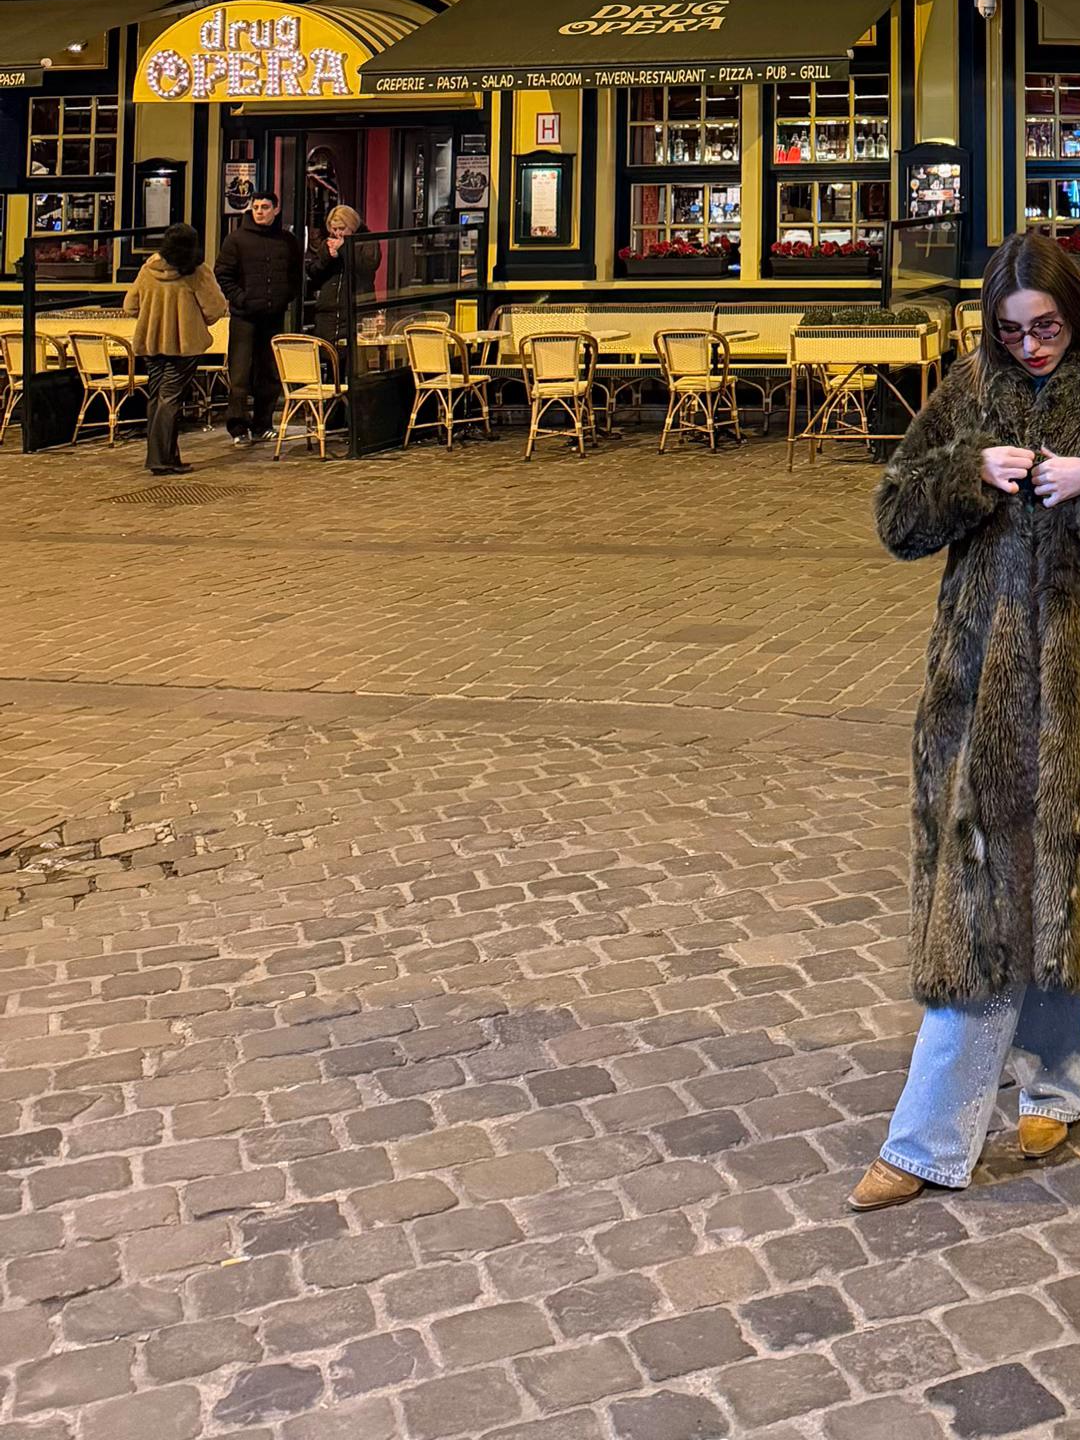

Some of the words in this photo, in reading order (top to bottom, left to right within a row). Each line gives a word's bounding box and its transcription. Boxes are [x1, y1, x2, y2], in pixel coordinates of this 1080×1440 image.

[590, 0, 730, 20] DRUG
[200, 7, 302, 56] drug
[558, 16, 727, 36] OPERA
[146, 48, 354, 100] OPERA
[376, 76, 425, 91] CREPERIE
[436, 75, 469, 90] PASTA
[481, 74, 515, 89] SALAD
[526, 72, 582, 87] TEA-ROOM
[594, 68, 707, 86] TAVERN-RESTAURANT
[718, 66, 754, 82] PIZZA
[765, 65, 787, 80] PUB
[799, 64, 831, 80] GRILL
[541, 118, 556, 140] H
